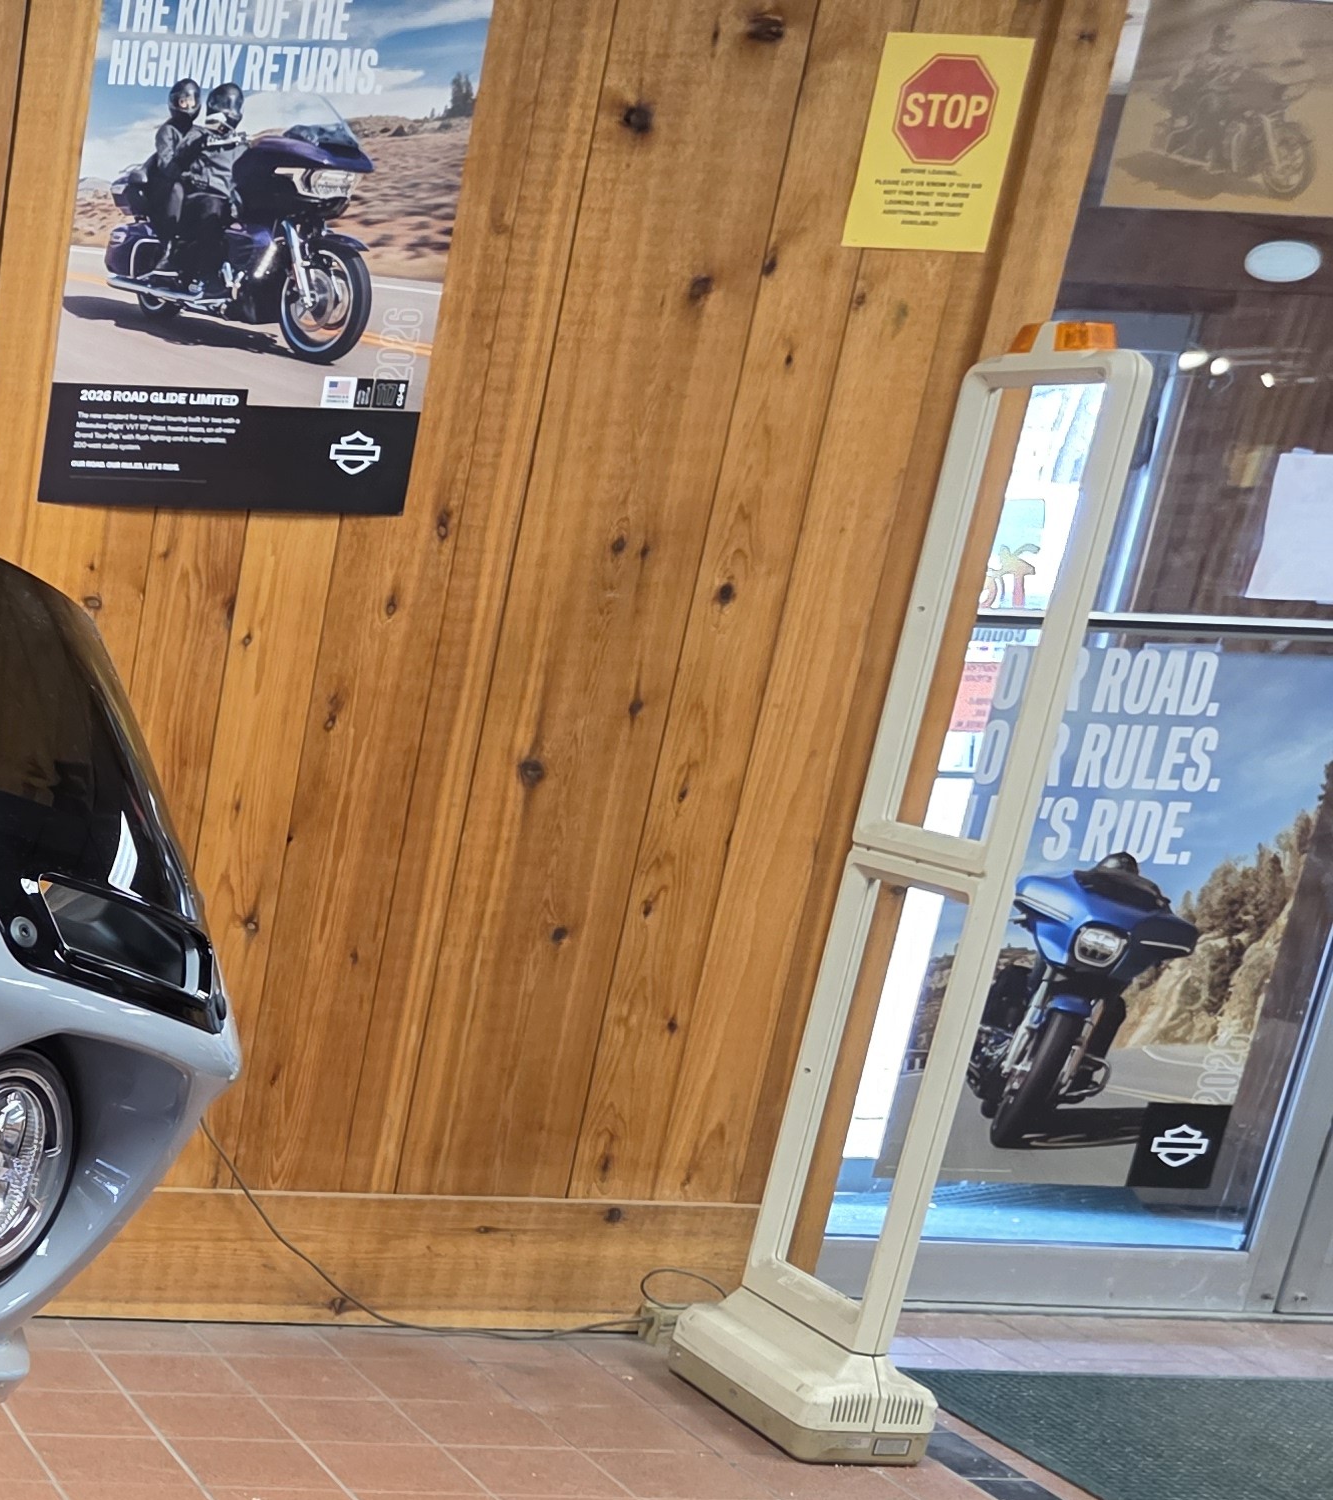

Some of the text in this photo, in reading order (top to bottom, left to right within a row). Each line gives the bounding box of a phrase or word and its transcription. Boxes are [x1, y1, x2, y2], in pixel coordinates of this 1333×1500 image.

[118, 0, 353, 41] THE KING OF THE
[107, 39, 382, 95] HIGHWAY RETURNS.
[902, 92, 989, 129] STOP
[374, 308, 423, 386] 2026
[80, 389, 239, 406] 2026 ROAD GLIDE LIMITED
[992, 645, 1220, 717] OR ROAD.
[973, 719, 1221, 792] OR RULES.
[1079, 798, 1192, 866] RIDE.
